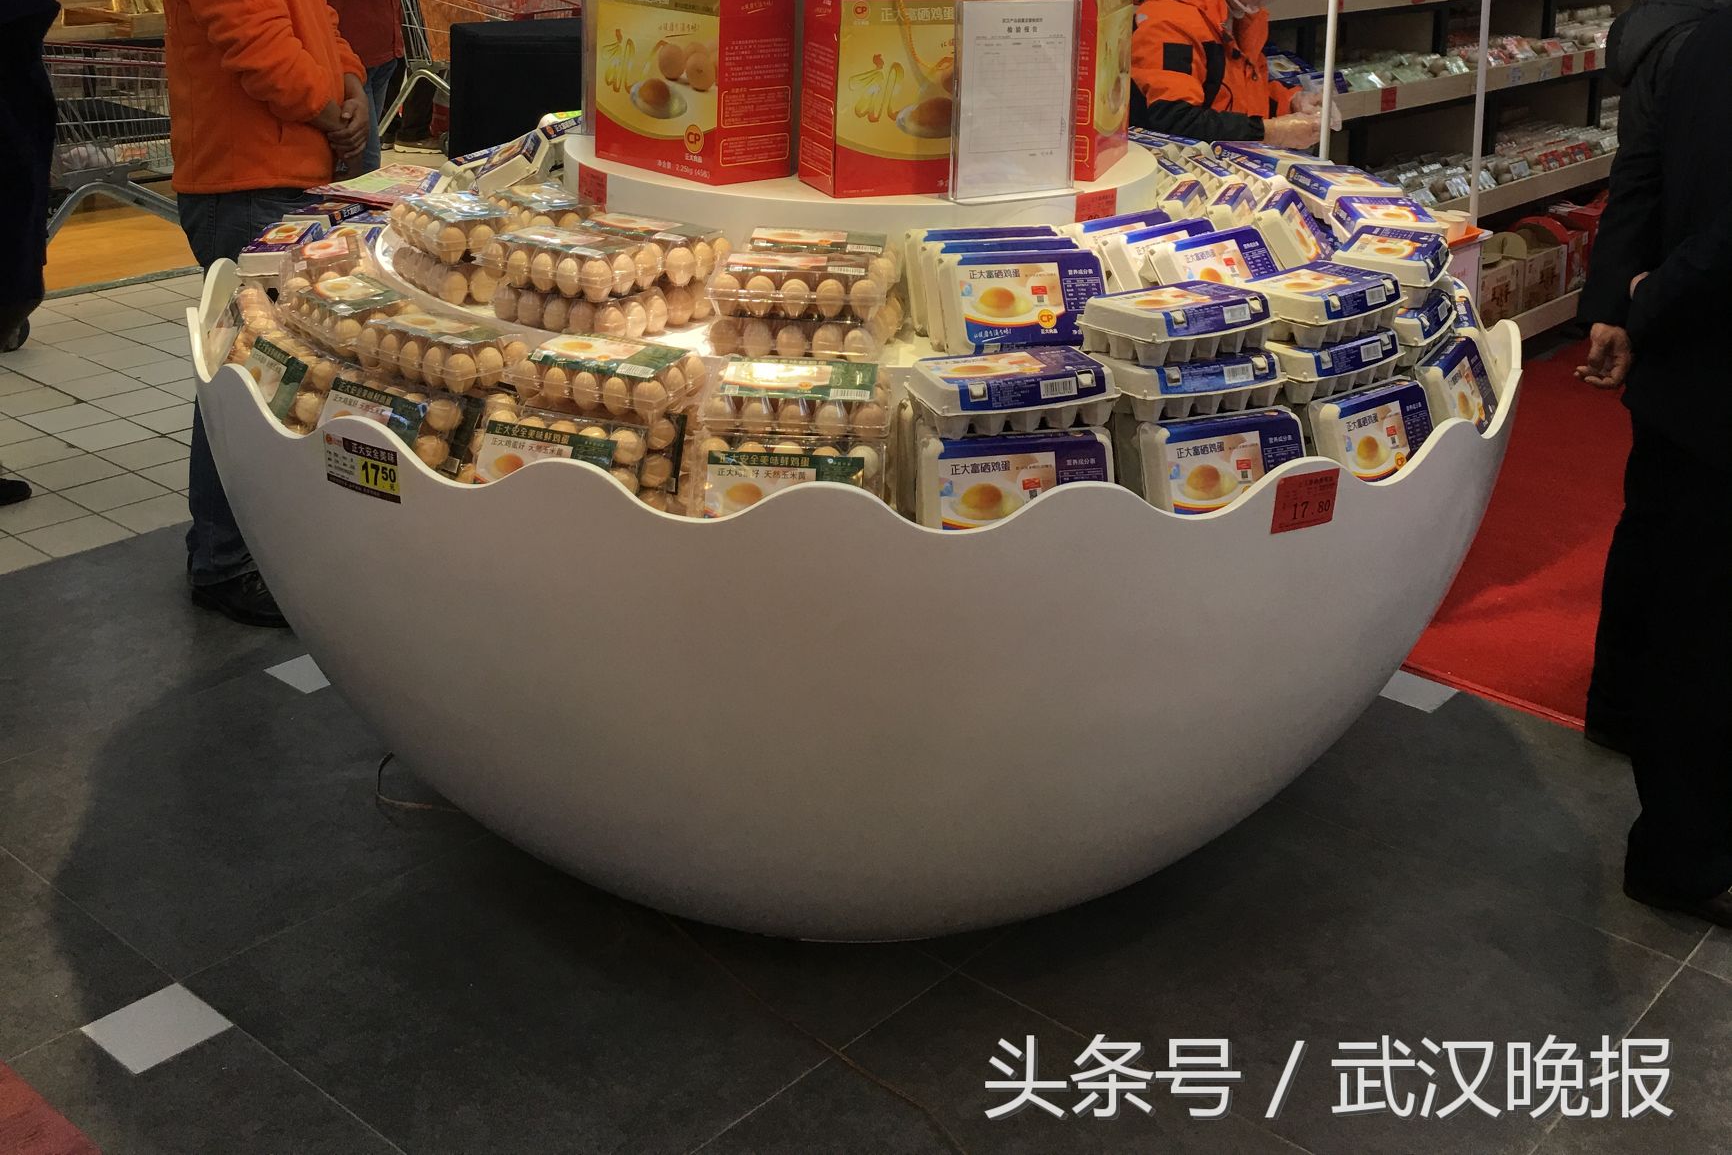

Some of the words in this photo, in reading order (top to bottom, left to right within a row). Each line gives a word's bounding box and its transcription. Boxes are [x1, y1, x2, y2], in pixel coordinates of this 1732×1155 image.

[855, 6, 867, 15] CP
[688, 132, 700, 144] CP
[968, 268, 1021, 280] 正大富硒鸡蛋
[1067, 268, 1094, 276] 营养成分表
[1040, 314, 1053, 323] CP
[495, 423, 570, 444] 正大安全美味鲜鸡蛋
[351, 442, 396, 464] 正大安全美味
[1176, 441, 1225, 459] 正大富硒鸡蛋
[950, 460, 1011, 476] 正大富硒鸡蛋
[763, 469, 807, 480] 天然玉米黄
[1292, 499, 1331, 521] 17.80
